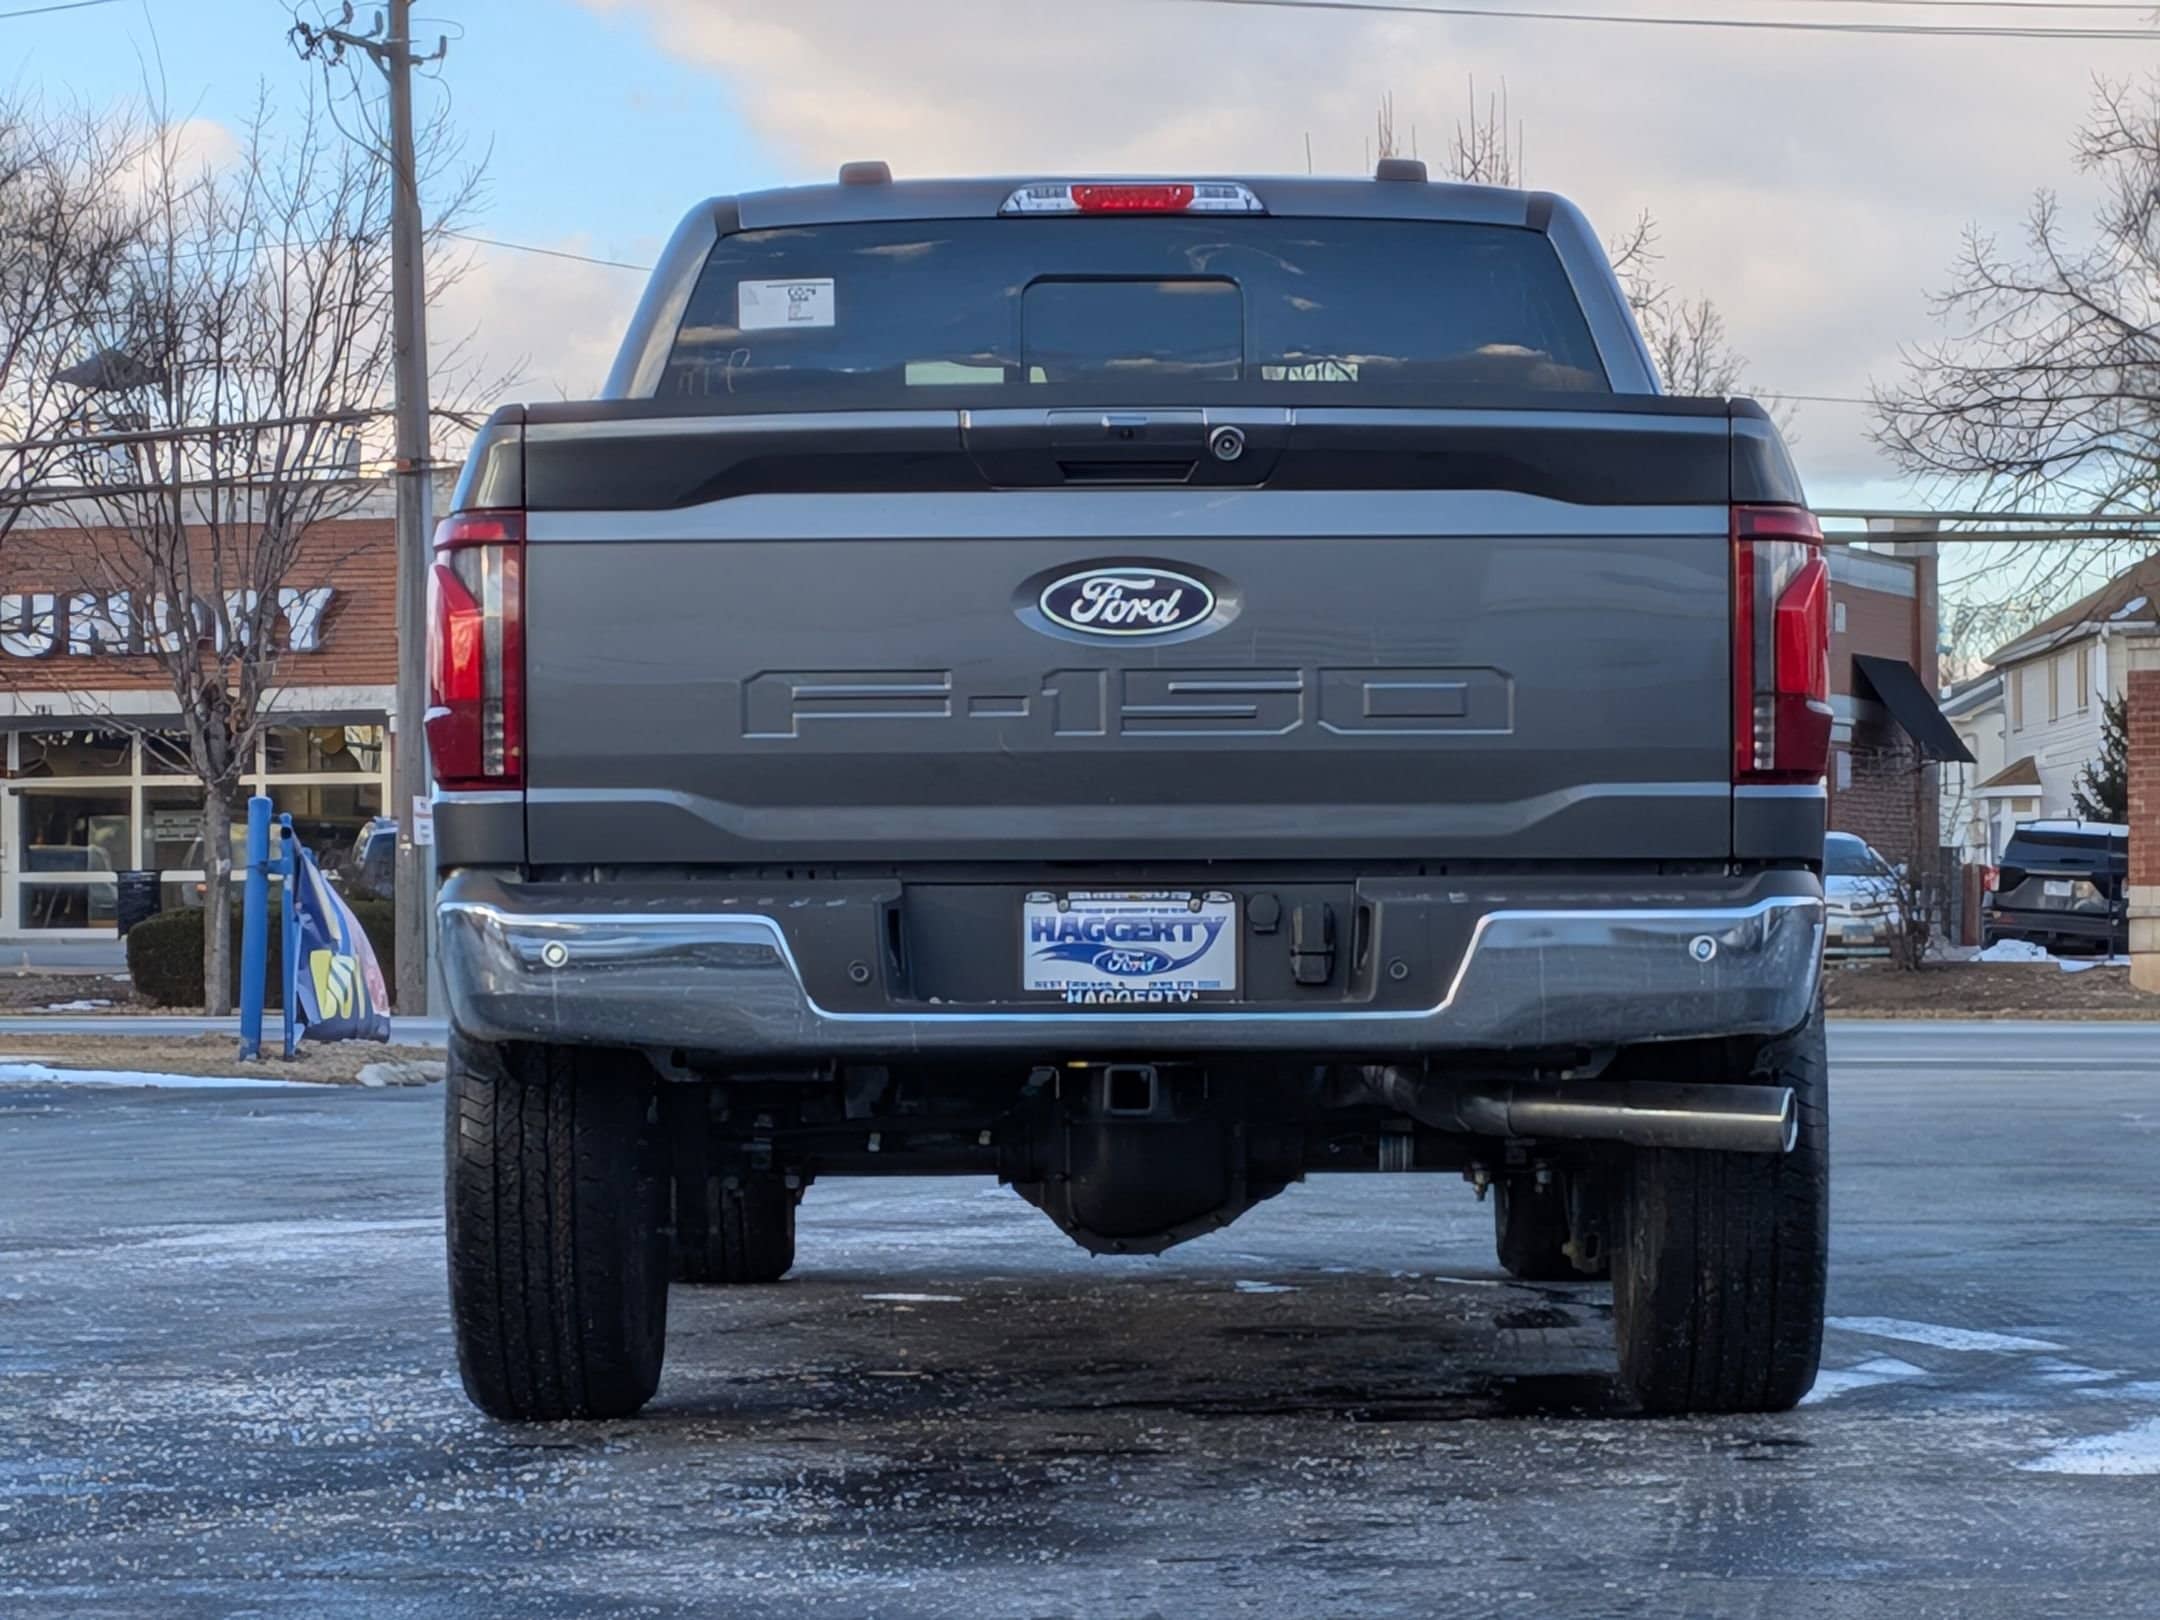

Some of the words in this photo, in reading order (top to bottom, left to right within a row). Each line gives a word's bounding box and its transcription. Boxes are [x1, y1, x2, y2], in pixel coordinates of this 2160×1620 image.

[1071, 577, 1183, 624] Ford
[742, 667, 1517, 737] F-150
[1031, 916, 1227, 945] HAGGERTY
[1106, 952, 1158, 973] Ford
